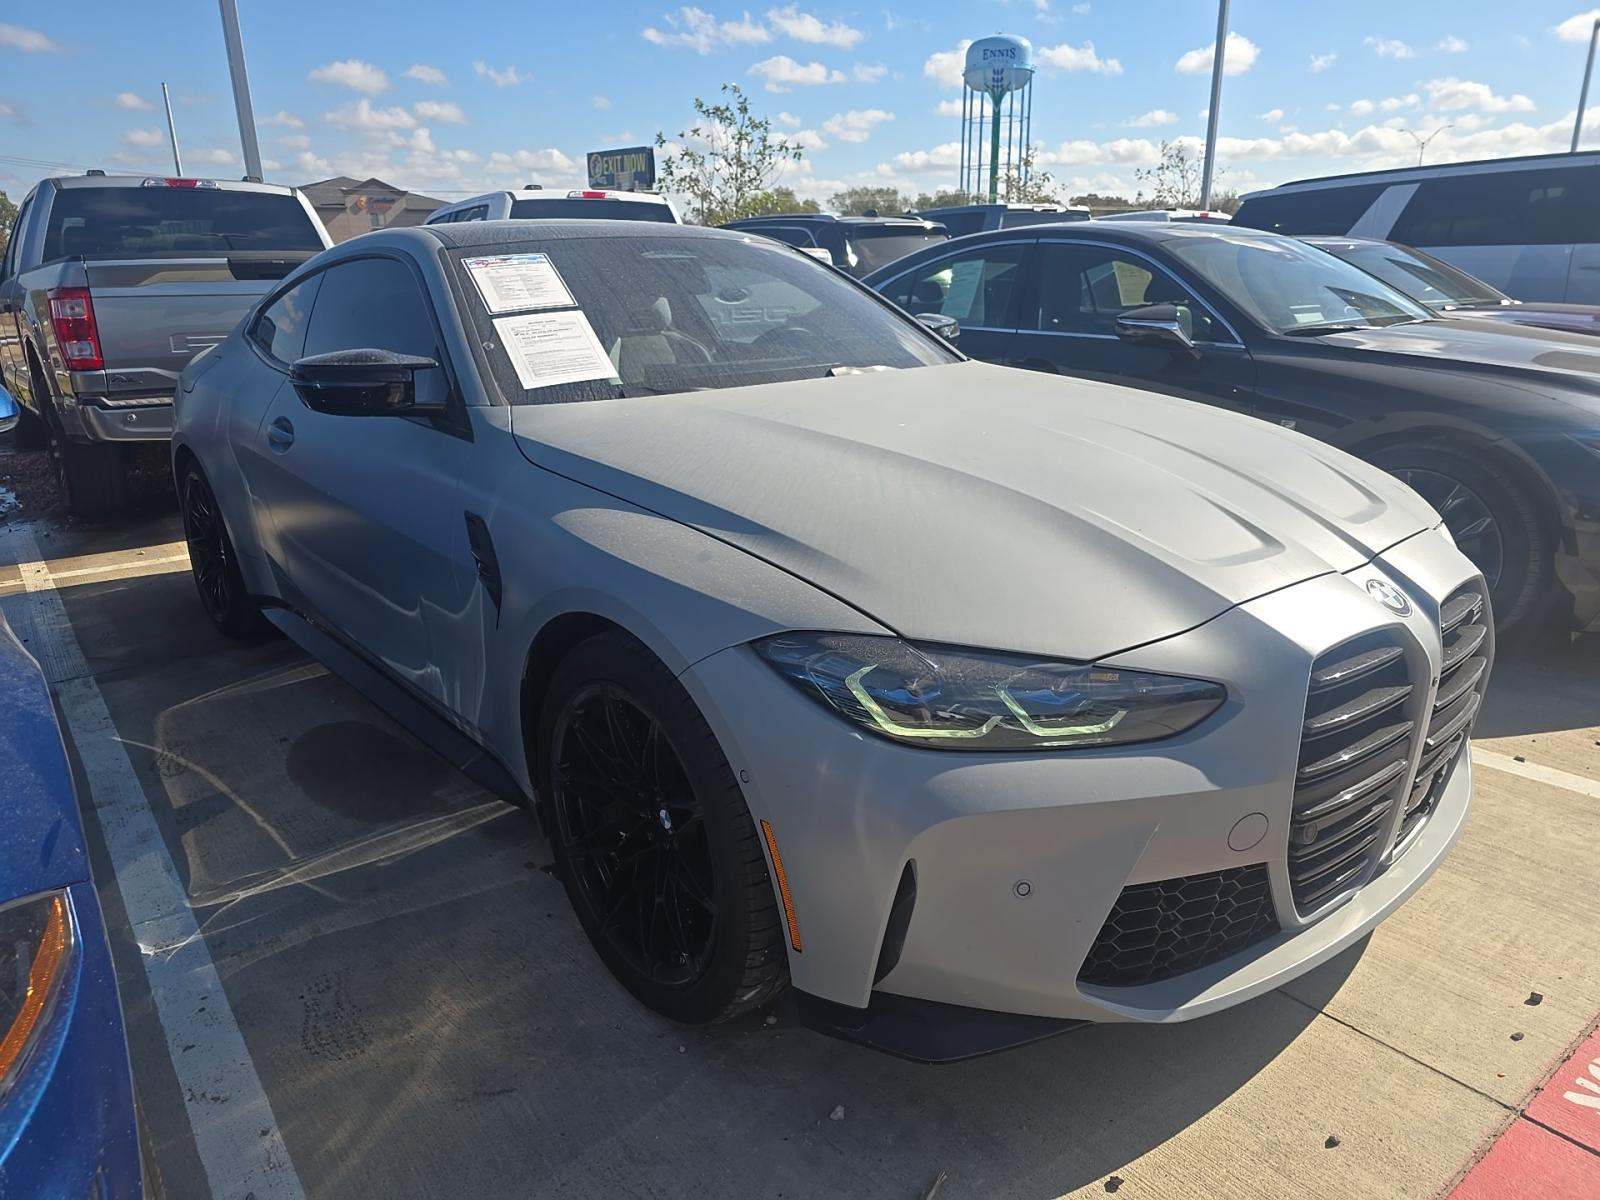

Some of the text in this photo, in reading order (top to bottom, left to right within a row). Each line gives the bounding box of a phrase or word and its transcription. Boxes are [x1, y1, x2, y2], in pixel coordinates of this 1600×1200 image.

[983, 47, 1016, 61] ENNIS
[602, 153, 646, 175] EXIT NOW
